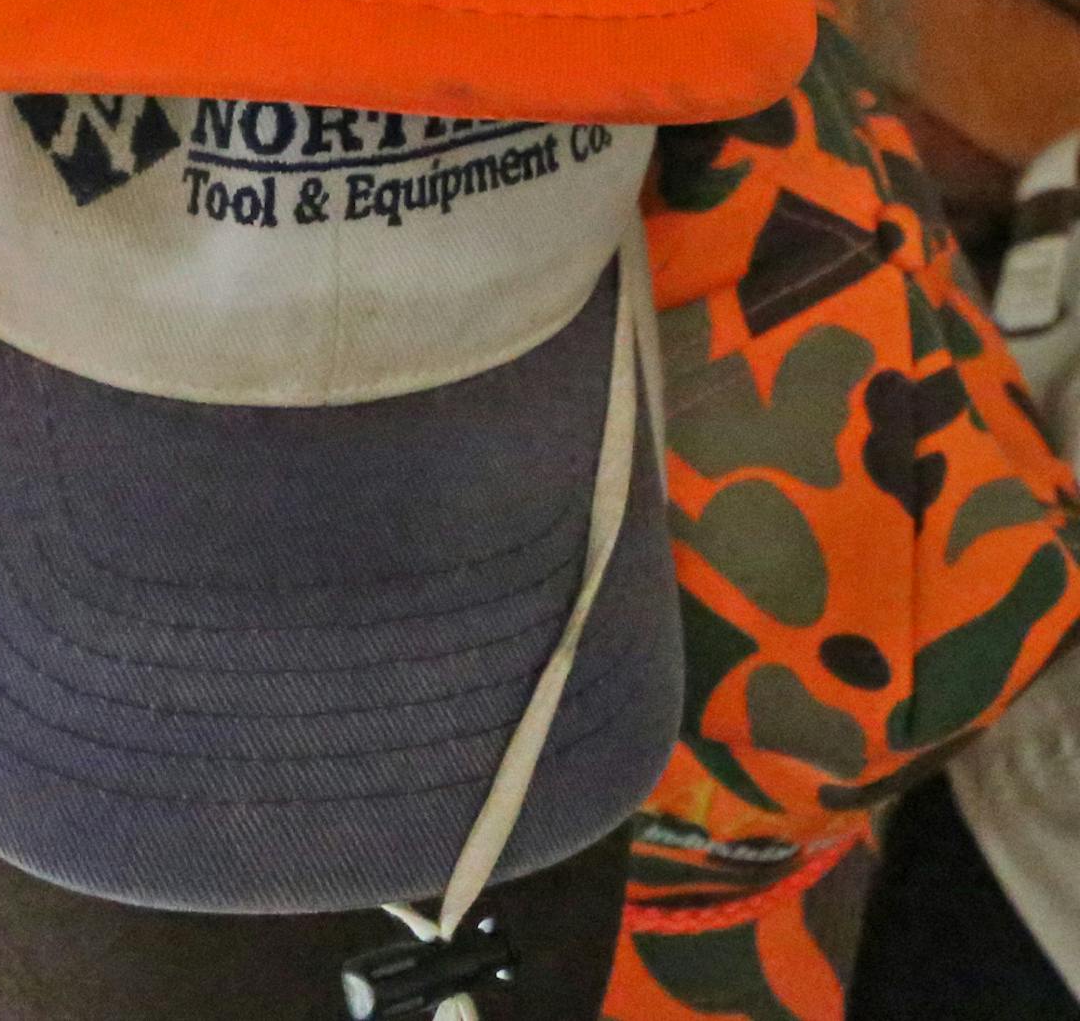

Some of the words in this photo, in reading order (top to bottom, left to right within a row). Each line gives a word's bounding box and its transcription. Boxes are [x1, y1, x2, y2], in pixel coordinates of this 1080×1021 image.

[190, 97, 500, 156] NORT
[182, 167, 277, 228] Tool
[293, 177, 330, 224] &
[345, 132, 560, 227] Equipment
